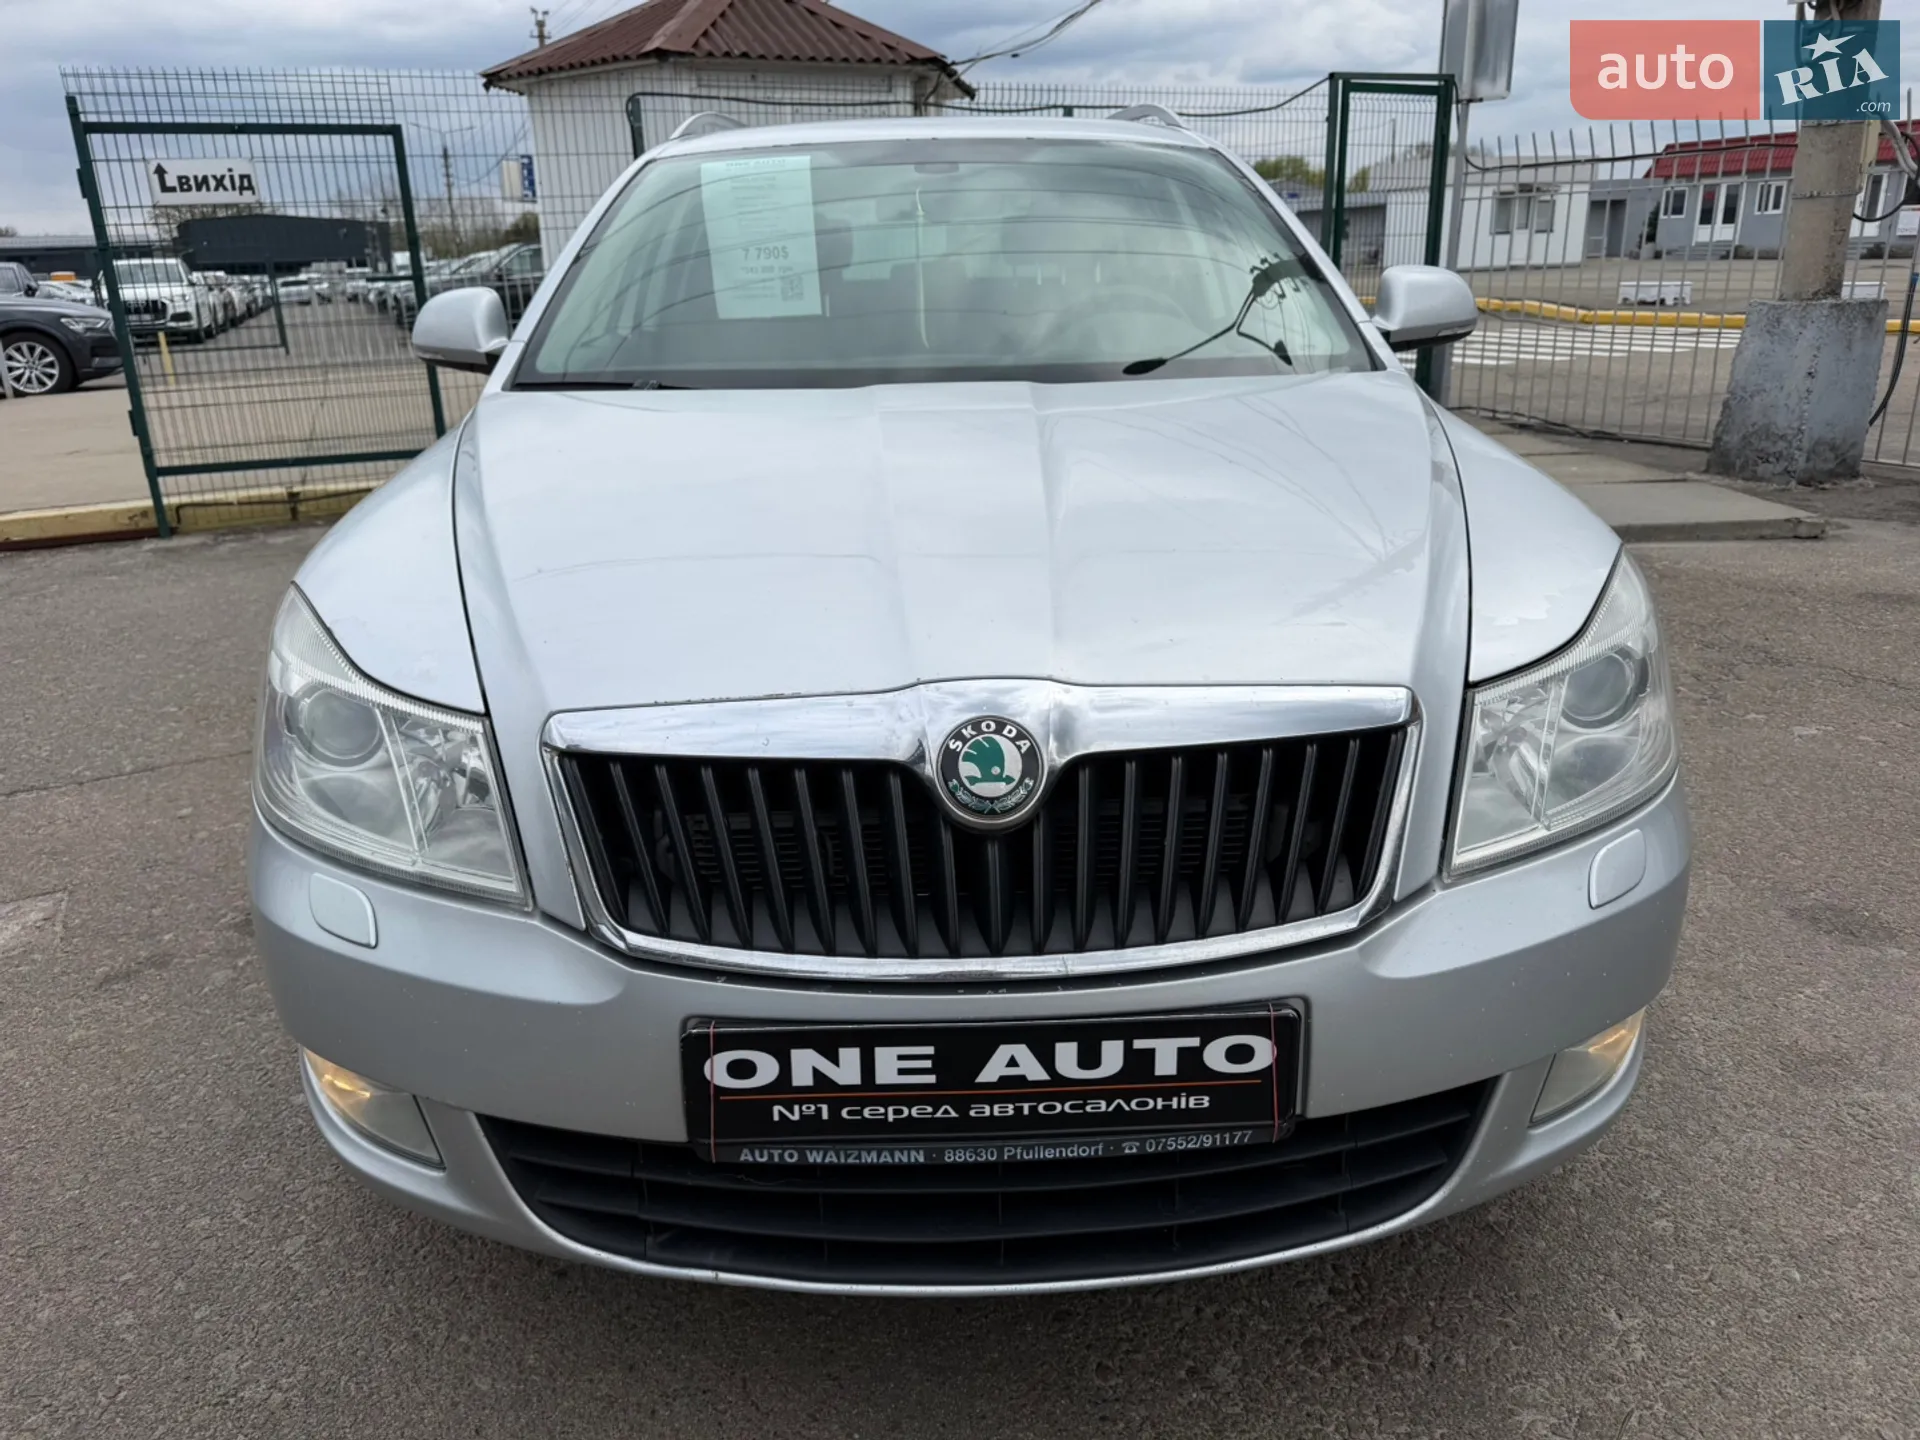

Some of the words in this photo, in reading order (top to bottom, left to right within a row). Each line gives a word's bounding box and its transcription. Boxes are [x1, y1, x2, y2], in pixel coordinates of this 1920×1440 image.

[176, 168, 256, 196] вихід
[948, 720, 1032, 754] SKODA
[704, 1045, 937, 1089] ONE
[974, 1034, 1277, 1083] AUTO
[840, 1104, 959, 1122] серед
[968, 1092, 1210, 1117] автосалонів
[739, 1148, 799, 1164] AUTO
[806, 1148, 925, 1164] WAIZMANN
[944, 1148, 998, 1162] 88630
[1003, 1142, 1104, 1161] Pfullendorf
[1145, 1130, 1253, 1152] 07552/91177
